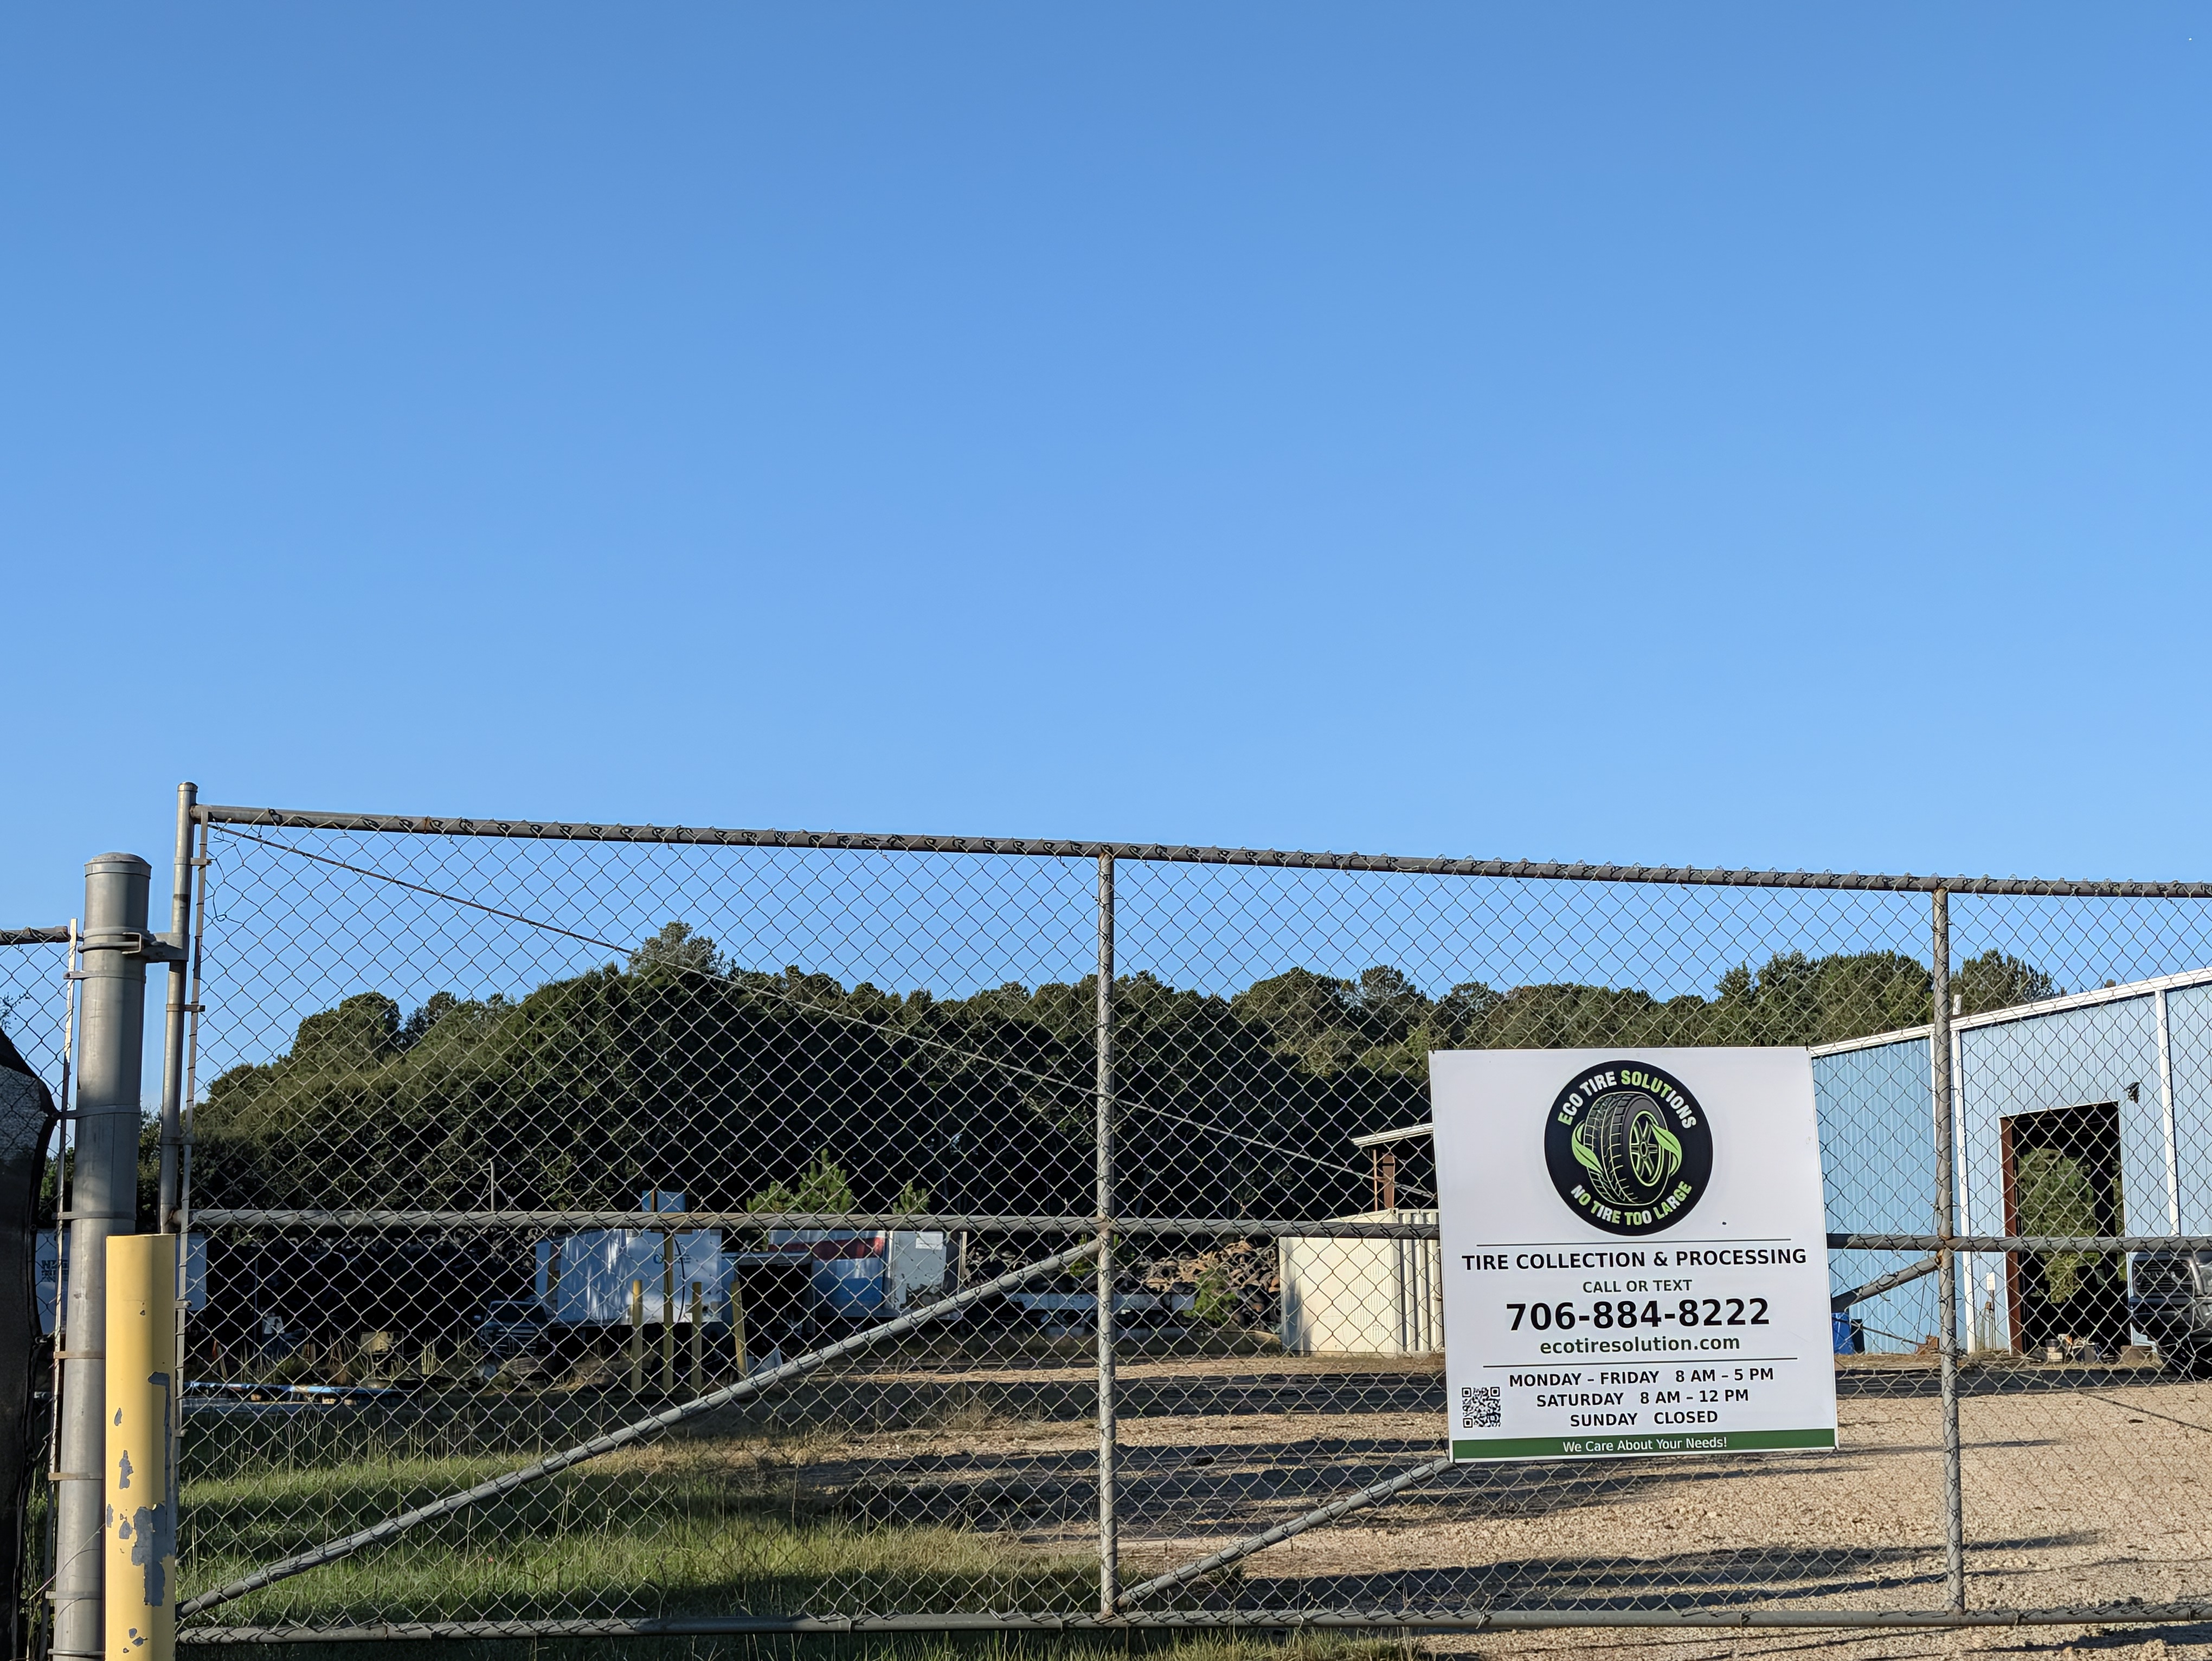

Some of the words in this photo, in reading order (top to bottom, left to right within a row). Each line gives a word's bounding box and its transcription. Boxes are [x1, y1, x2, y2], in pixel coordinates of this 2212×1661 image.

[1558, 1093, 1583, 1125] ECO
[1579, 1071, 1617, 1097] TIRE
[1621, 1070, 1696, 1128] SOLUTIONS
[1570, 1184, 1591, 1206] NO
[1590, 1200, 1621, 1224] TIRE
[1624, 1210, 1652, 1226] TOO
[1653, 1181, 1692, 1220] LARGE
[1461, 1254, 1509, 1271] TIRE
[1516, 1252, 1645, 1270] COLLECTION
[1654, 1251, 1668, 1266] &
[1676, 1248, 1806, 1266] PROCESSING
[1583, 1280, 1622, 1293] CALL
[1626, 1280, 1649, 1292] OR
[1652, 1279, 1693, 1291] TEXT
[1506, 1297, 1770, 1331] 706-884-8222
[1540, 1336, 1740, 1354] ecotiresolution.com
[1509, 1373, 1582, 1387] MONDAY
[1600, 1370, 1660, 1385] FRIDAY
[1675, 1370, 1685, 1382] 8
[1690, 1369, 1715, 1382] AM
[1734, 1368, 1744, 1381] 5
[1750, 1367, 1773, 1380] PM
[1536, 1392, 1624, 1407] SATURDAY
[1640, 1392, 1650, 1405] 8
[1655, 1390, 1680, 1404] AM
[1699, 1389, 1719, 1402] 12
[1725, 1389, 1748, 1402] PM
[1570, 1412, 1638, 1427] SUNDAY
[1654, 1411, 1718, 1425] CLOSED
[1562, 1441, 1582, 1452] We
[1585, 1441, 1613, 1452] Care
[1617, 1439, 1653, 1451] About
[1656, 1439, 1682, 1449] Your
[1686, 1437, 1727, 1448] Needs!
